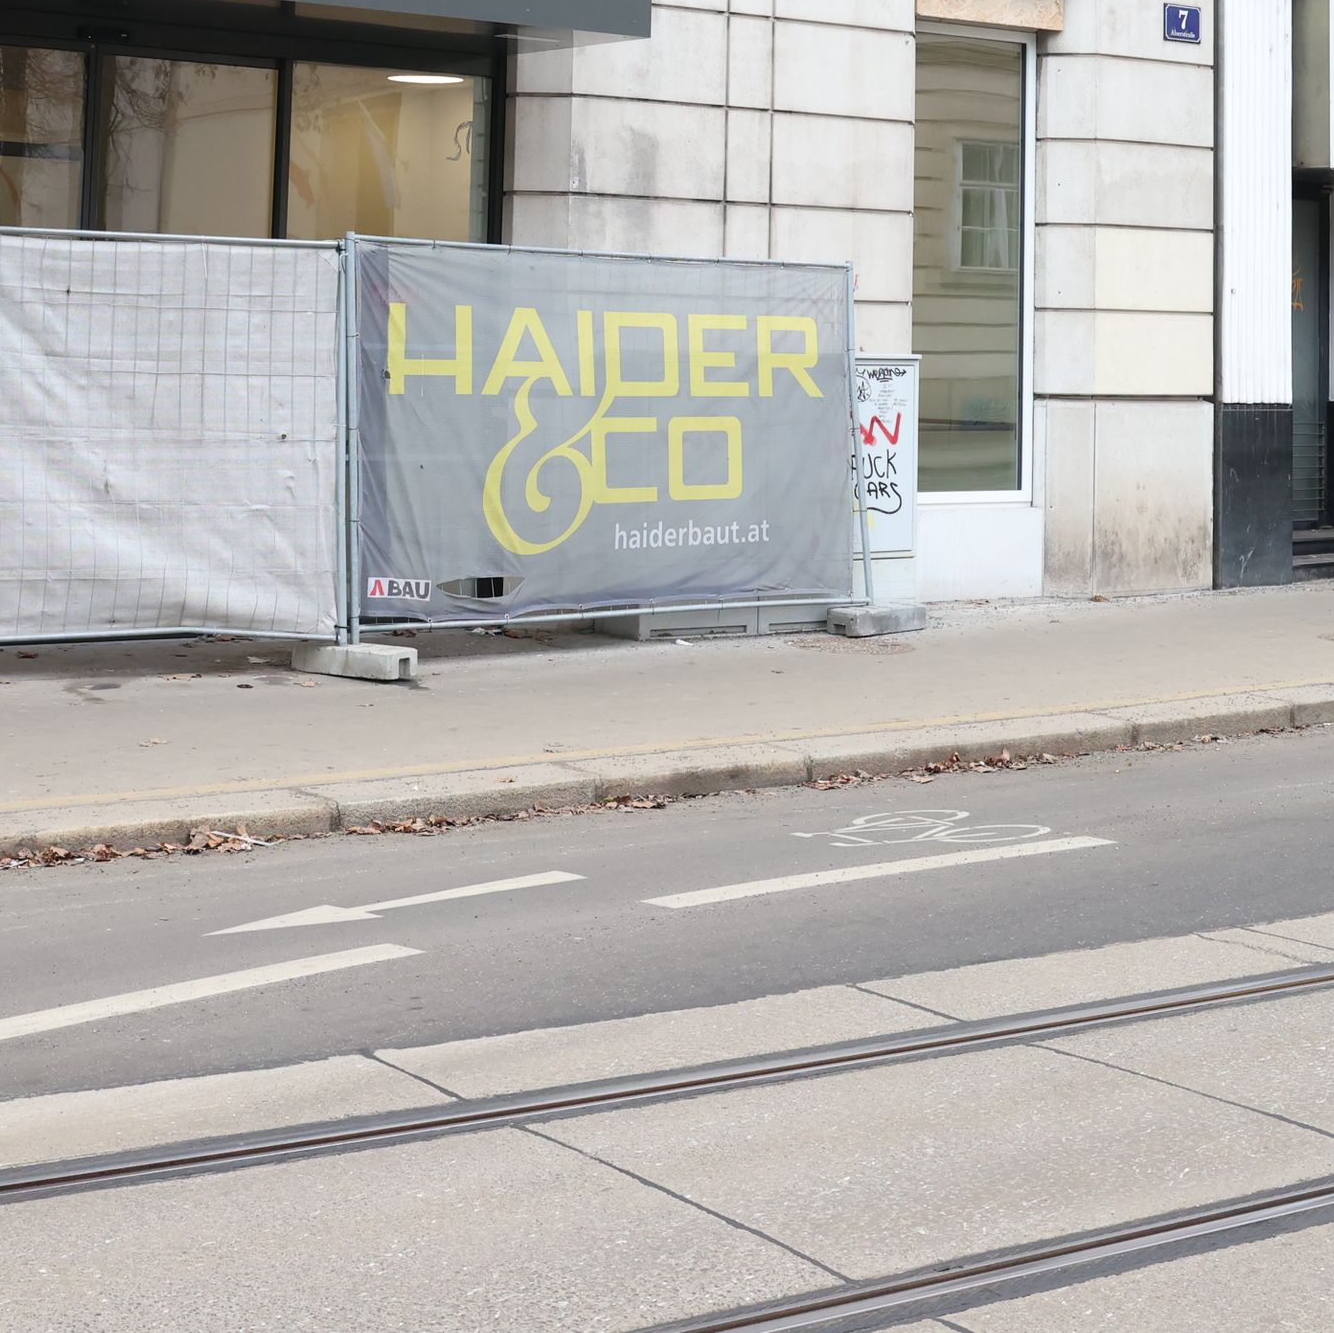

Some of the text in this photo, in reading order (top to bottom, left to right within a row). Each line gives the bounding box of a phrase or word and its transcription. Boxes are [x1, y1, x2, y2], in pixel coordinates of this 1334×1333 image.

[1178, 9, 1189, 30] 7
[387, 302, 825, 398] HAIDER
[613, 519, 771, 550] haiderbaut.at
